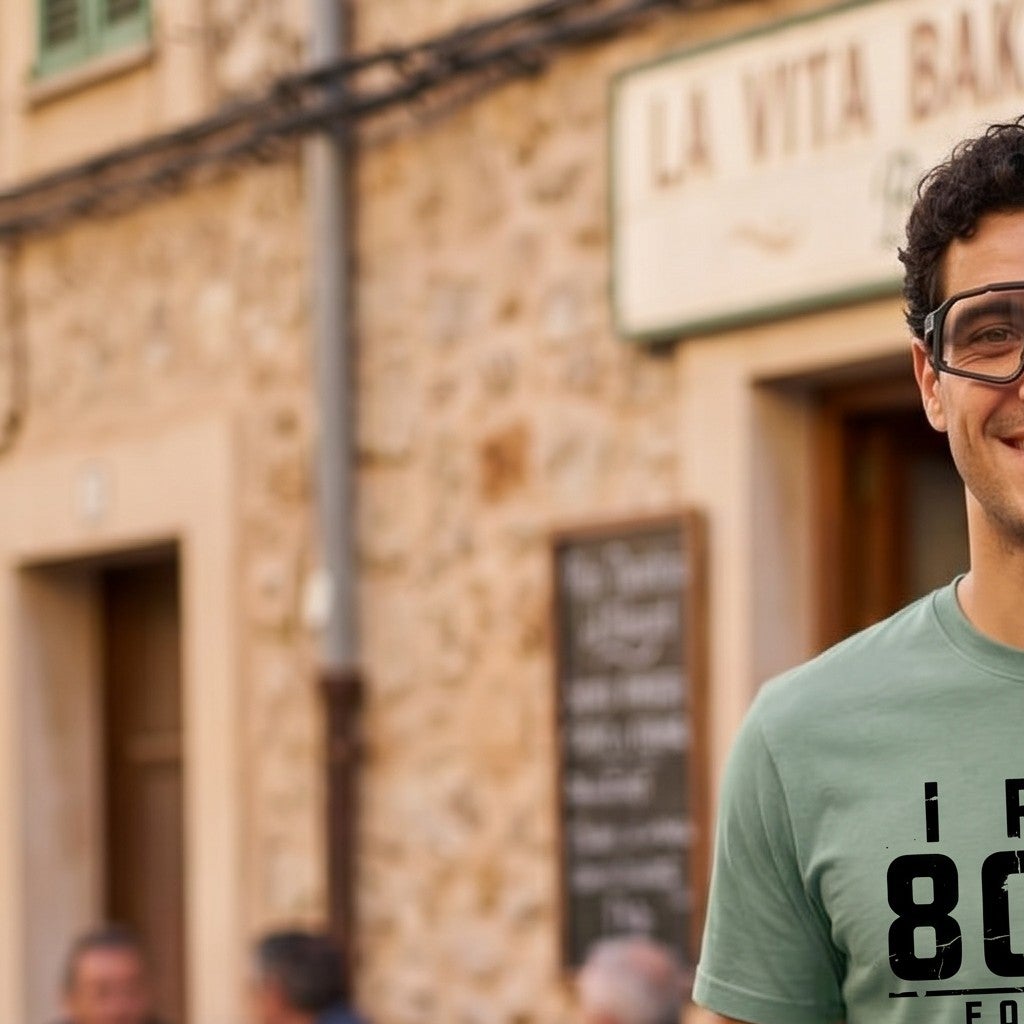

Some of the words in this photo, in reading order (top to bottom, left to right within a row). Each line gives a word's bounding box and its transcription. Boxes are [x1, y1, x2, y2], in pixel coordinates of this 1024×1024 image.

[647, 82, 716, 192] LA
[740, 38, 876, 168] VITA
[924, 781, 940, 843] I
